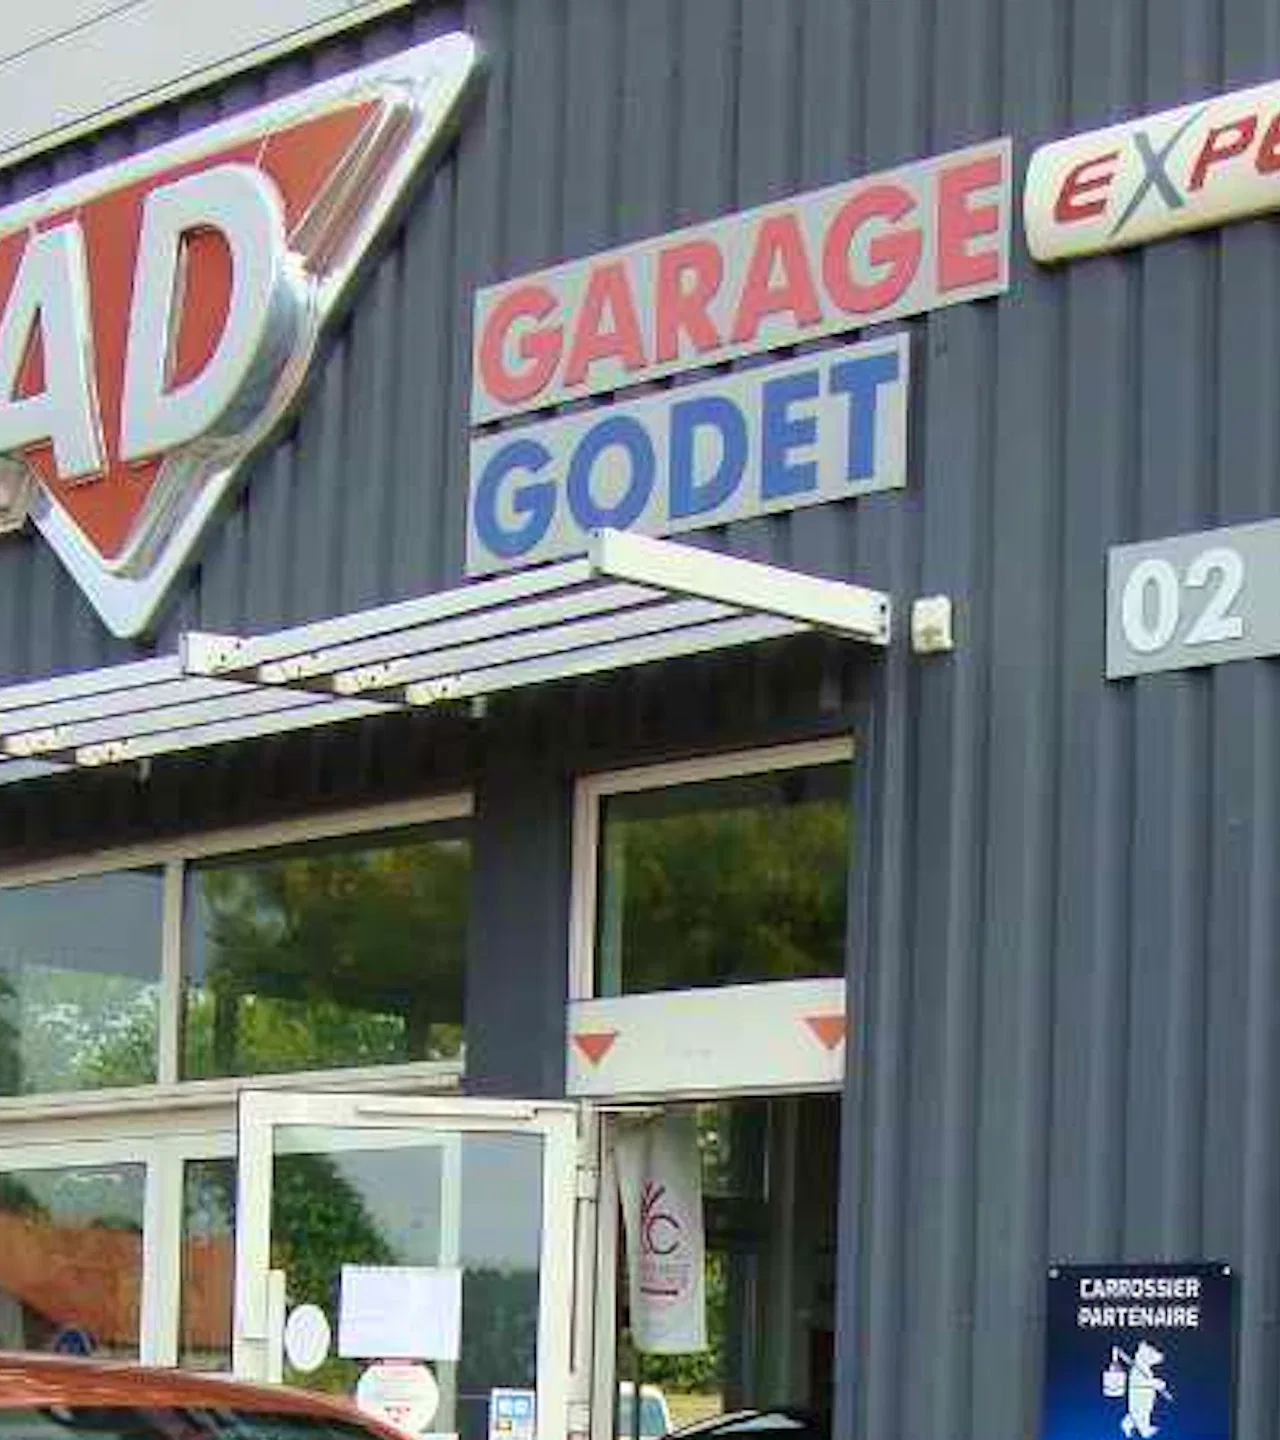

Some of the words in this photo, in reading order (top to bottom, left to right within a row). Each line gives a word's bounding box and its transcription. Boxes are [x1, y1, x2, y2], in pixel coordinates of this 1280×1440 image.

[478, 155, 1004, 405] GARAGE
[473, 353, 900, 560] GODET
[1121, 546, 1246, 655] 02
[1076, 1306, 1200, 1328] PARTENAIRE
[1079, 1277, 1202, 1300] CARROSSIER
